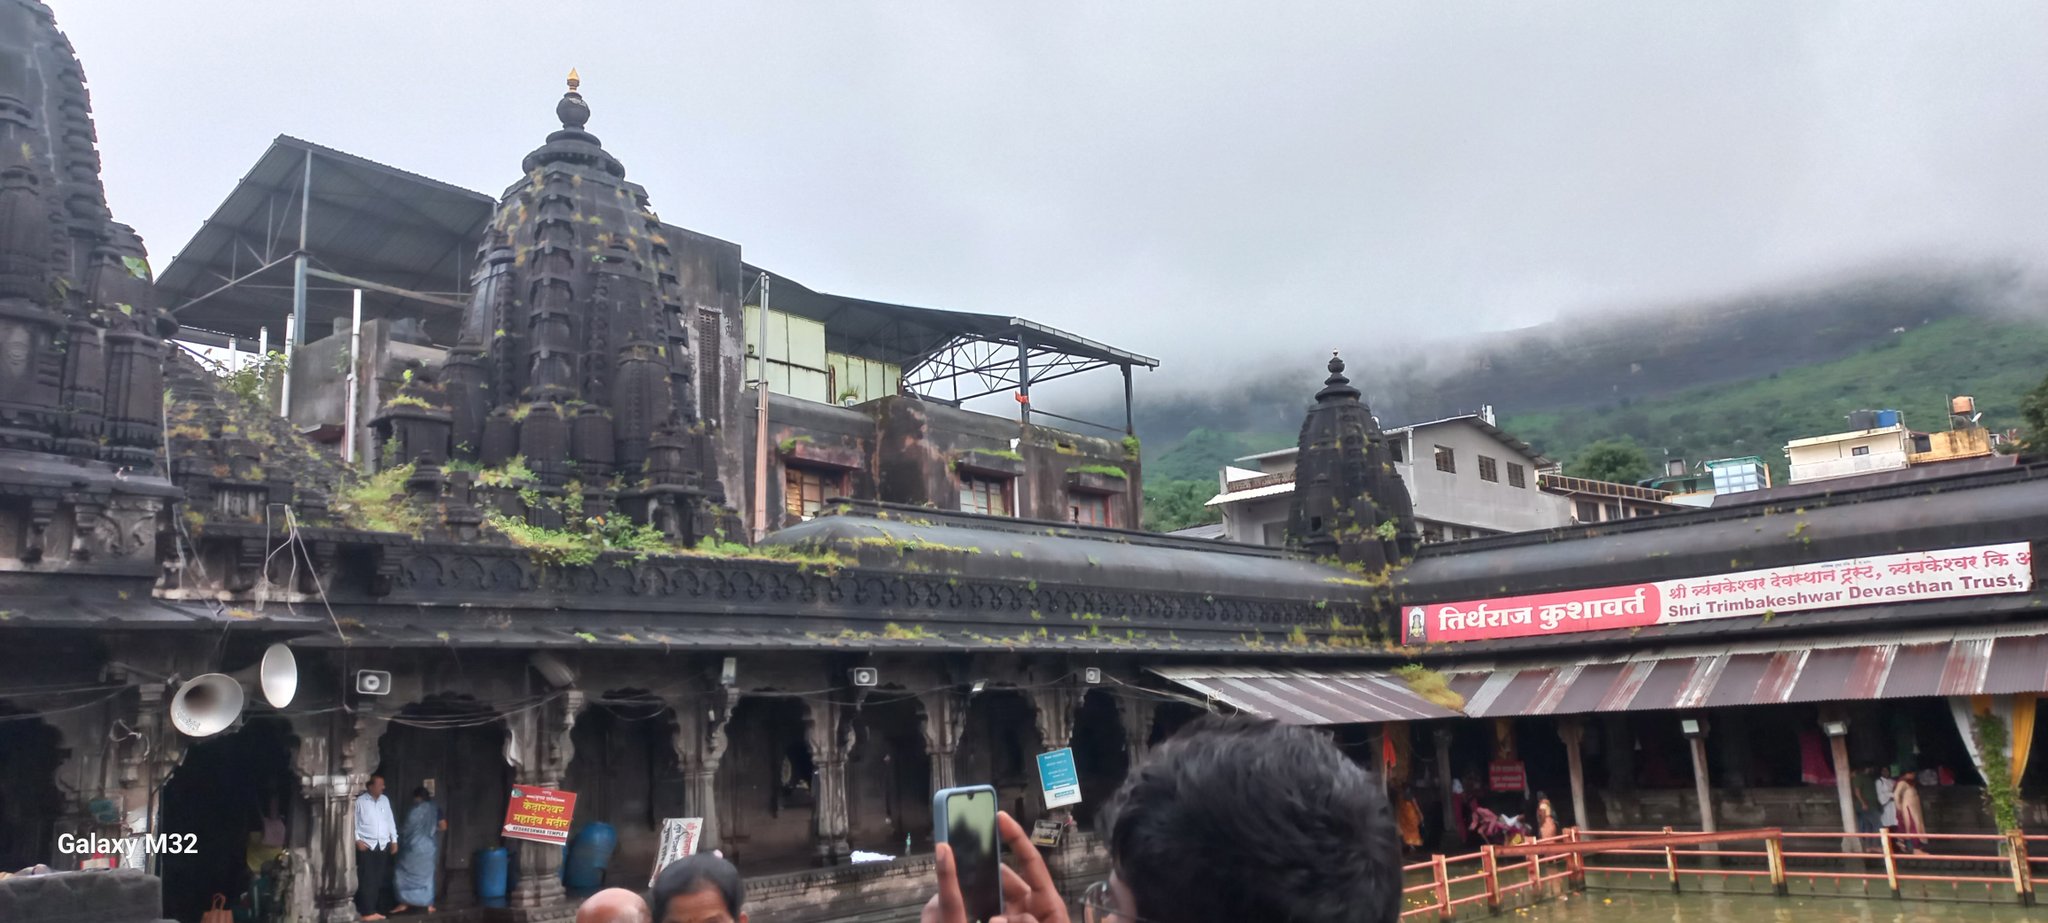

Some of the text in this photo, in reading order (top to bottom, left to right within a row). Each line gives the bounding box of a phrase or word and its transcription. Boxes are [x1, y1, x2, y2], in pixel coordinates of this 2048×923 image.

[1668, 573, 2023, 617] Shri Trimbakeshwar Devasthan Trust,
[1669, 583, 1687, 600] श्री
[1770, 569, 1836, 588] देवस्थान
[1840, 565, 1882, 585] ट्रस्ट,
[1983, 550, 2009, 568] कि
[1438, 588, 1646, 631] तिर्थराज कुशावर्त
[513, 812, 570, 829] महादेव मंदीर
[523, 799, 565, 814] केदारेश्वर
